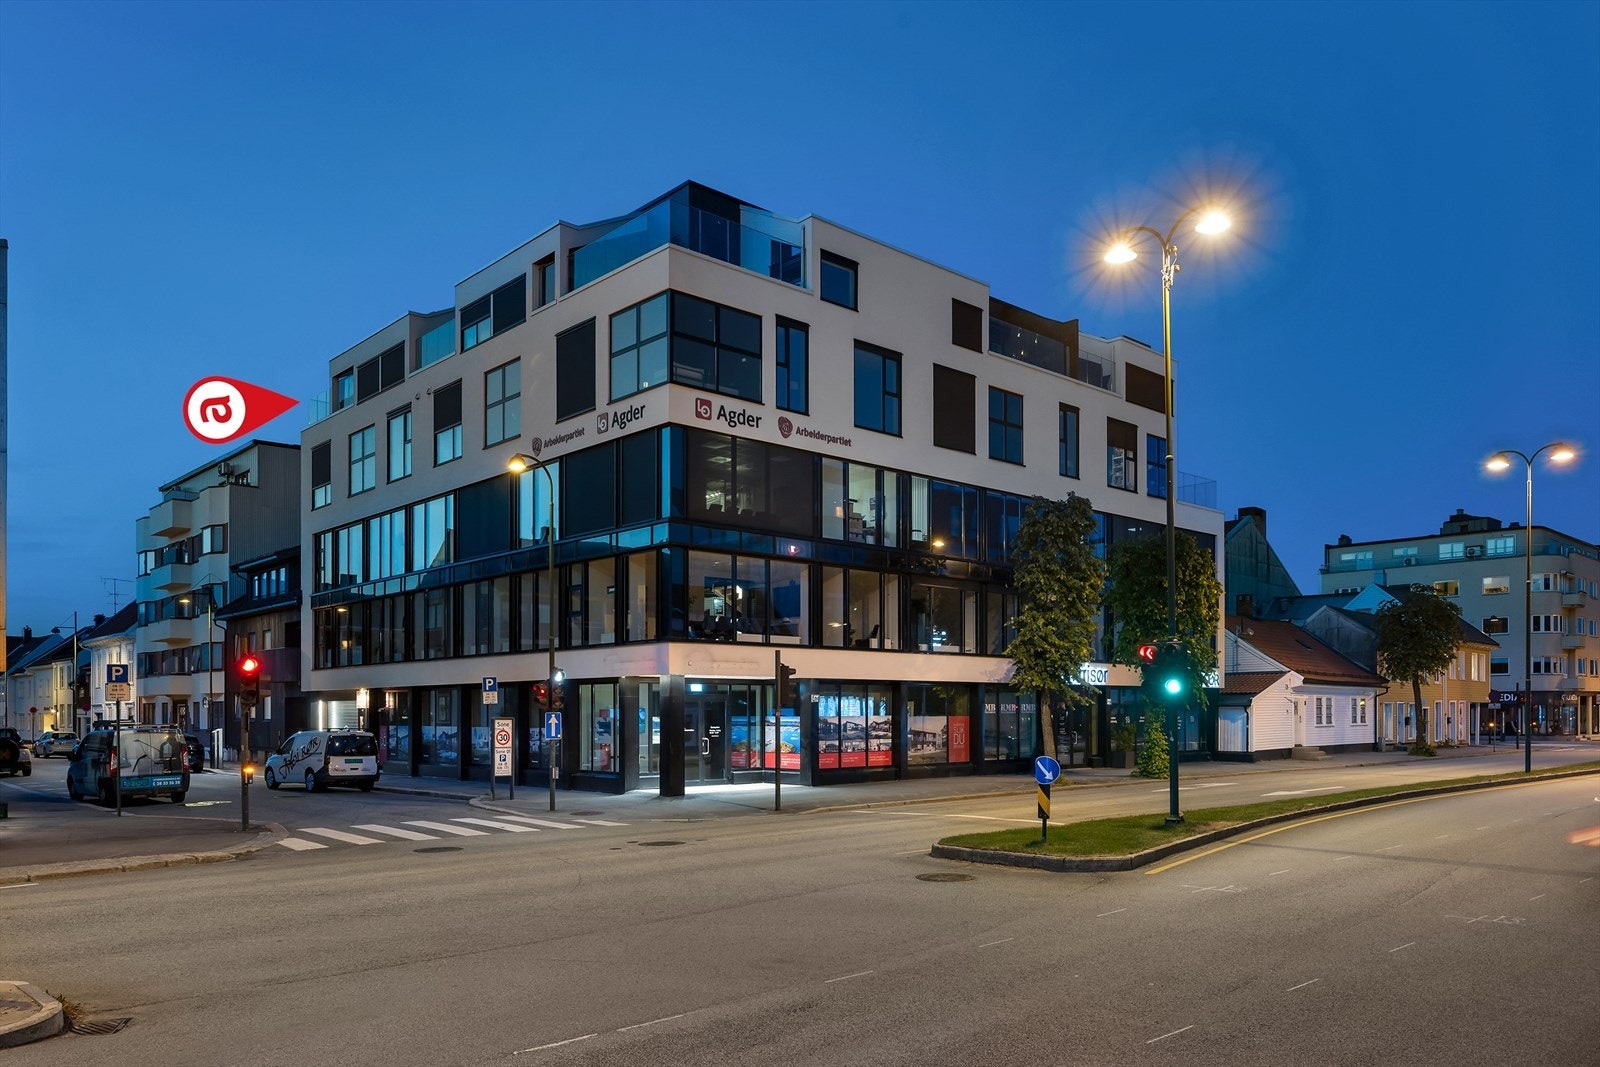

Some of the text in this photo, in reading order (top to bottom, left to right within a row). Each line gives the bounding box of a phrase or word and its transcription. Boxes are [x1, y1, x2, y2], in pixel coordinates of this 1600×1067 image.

[611, 405, 645, 430] Agder
[717, 405, 762, 428] Agder
[543, 427, 585, 449] Arbeiderpartiet
[796, 426, 852, 447] Arbeiderpartiet
[112, 666, 124, 681] P
[486, 679, 494, 690] P
[498, 733, 508, 742] 30
